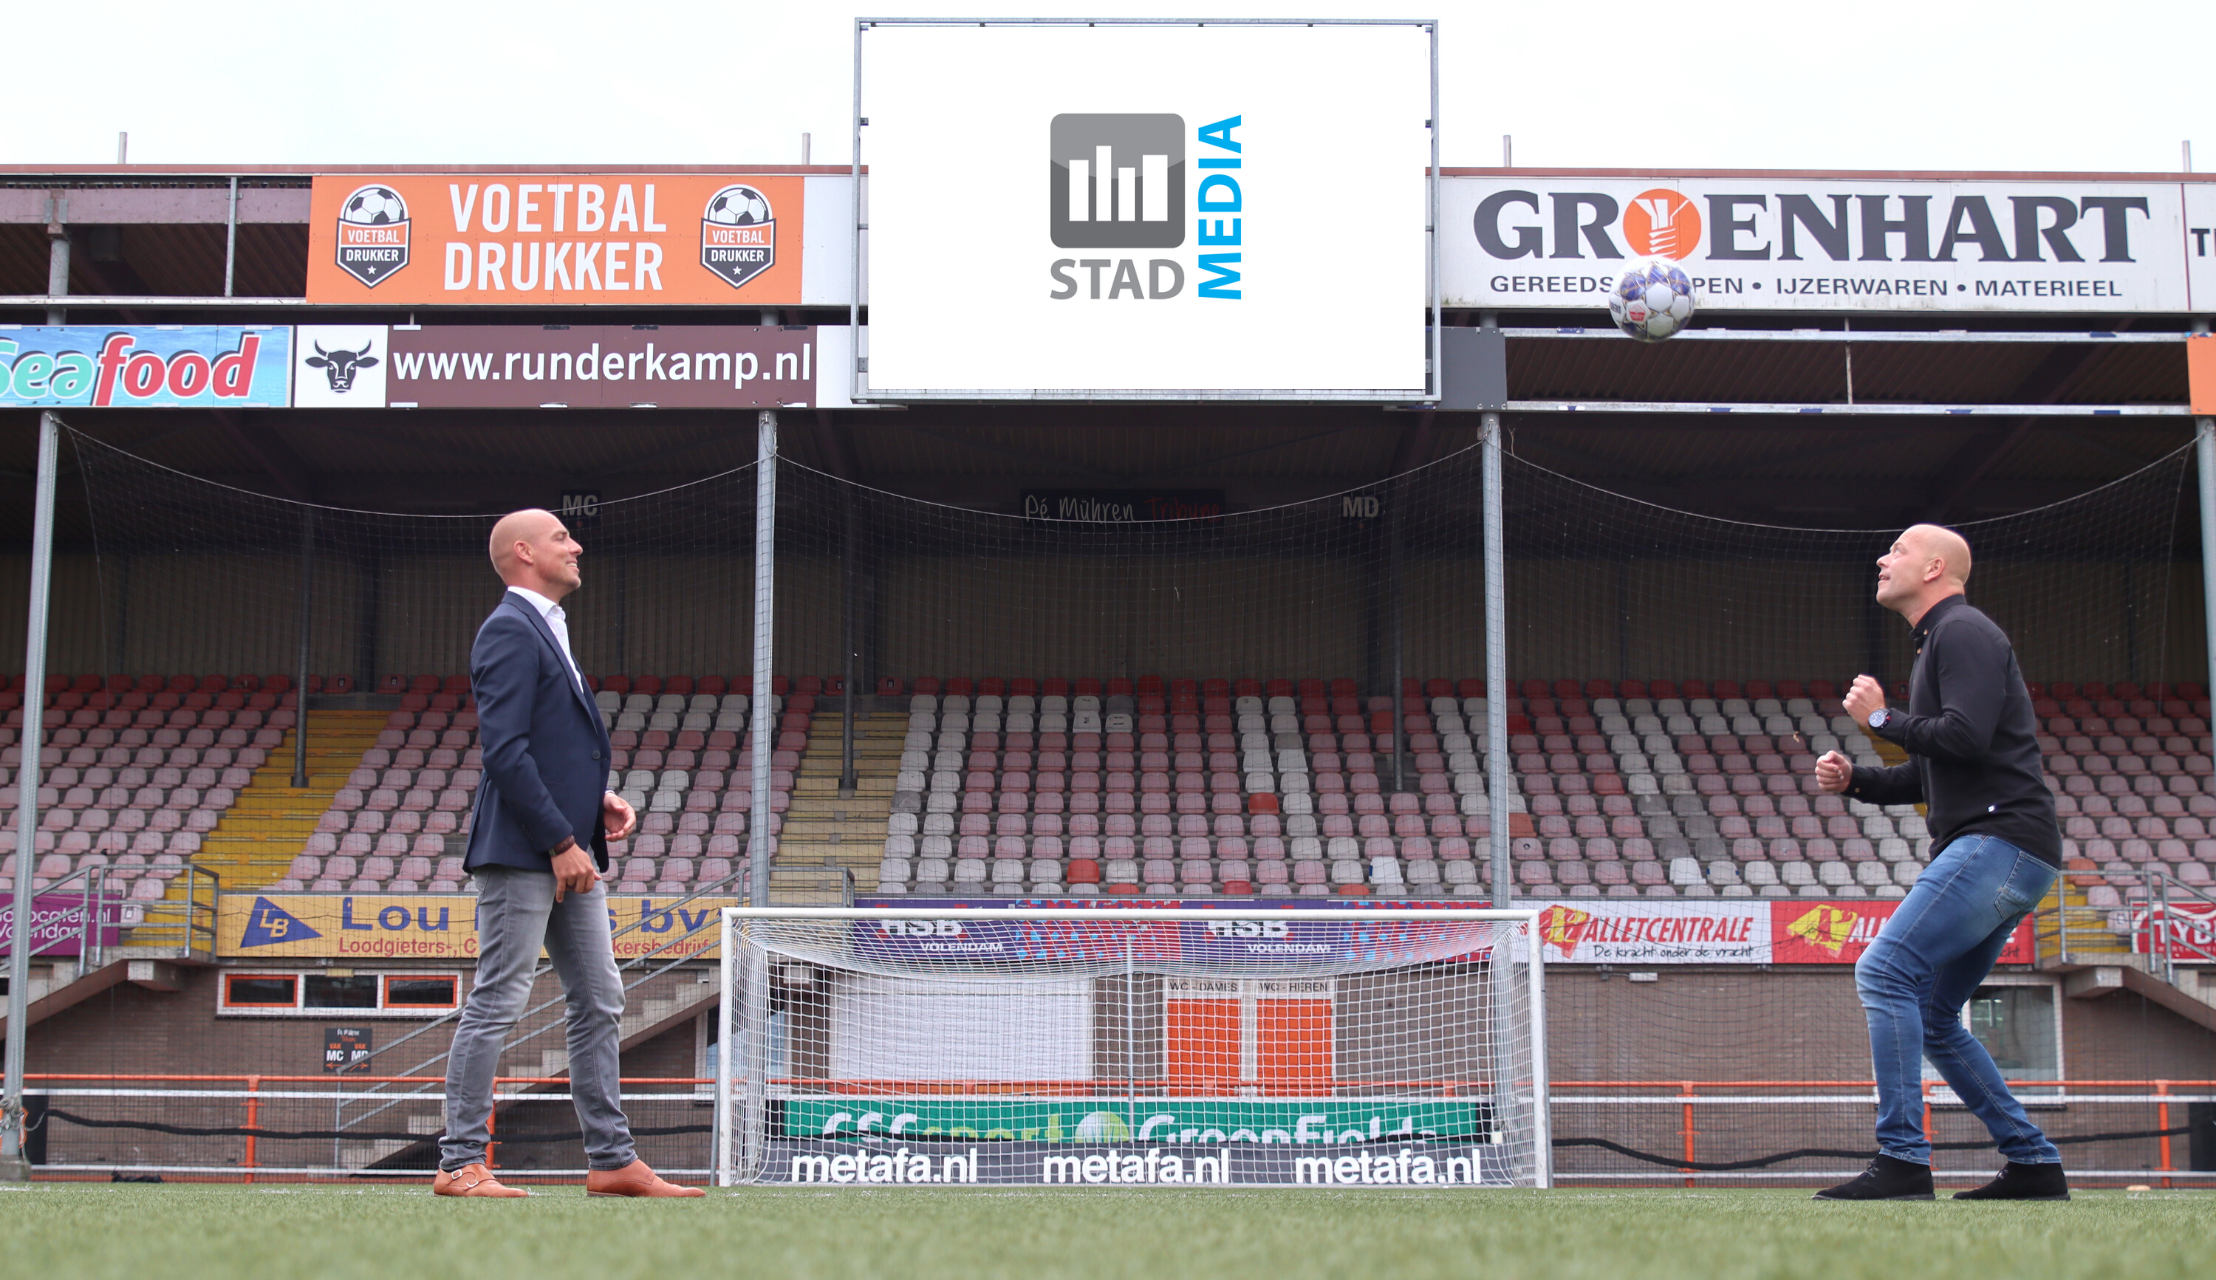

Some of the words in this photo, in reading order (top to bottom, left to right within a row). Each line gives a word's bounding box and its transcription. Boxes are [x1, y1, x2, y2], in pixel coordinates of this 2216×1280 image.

[449, 183, 667, 233] VOETBAL
[1198, 114, 1242, 300] MEDIA
[347, 229, 400, 243] VOETBAL
[711, 229, 765, 244] VOETBAL
[1473, 188, 2151, 263] GROENHART
[346, 248, 399, 262] DRUKKER
[710, 248, 764, 262] DRUKKER
[444, 241, 663, 292] DRUKKER
[1050, 258, 1185, 300] STAD
[1777, 278, 1948, 296] IJZERWAREN
[1975, 280, 2123, 297] MATERIEEL
[393, 342, 811, 390] www.runderkamp.nl
[562, 494, 598, 516] MC
[1025, 494, 1050, 522] Pé
[1060, 496, 1135, 523] Mühren
[1144, 495, 1222, 522] Tribune
[1343, 496, 1379, 518] MD
[259, 908, 290, 938] LB
[342, 896, 449, 931] Lou
[920, 942, 1004, 953] VOLENDAM
[1247, 943, 1331, 954] VOLENDAM
[1593, 945, 1612, 958] De
[1616, 945, 1655, 958] kracht
[1660, 945, 1690, 958] onder
[1695, 945, 1711, 958] de
[1716, 945, 1754, 958] vracht
[1169, 982, 1188, 992] WC
[1200, 982, 1238, 992] DAMES
[1259, 982, 1279, 992] WC
[1289, 982, 1328, 992] HEREN
[326, 1049, 344, 1062] MC
[791, 1147, 978, 1184] metafa.nl
[1043, 1147, 1229, 1184] metafa.nl
[1295, 1148, 1481, 1184] metafa.nl
